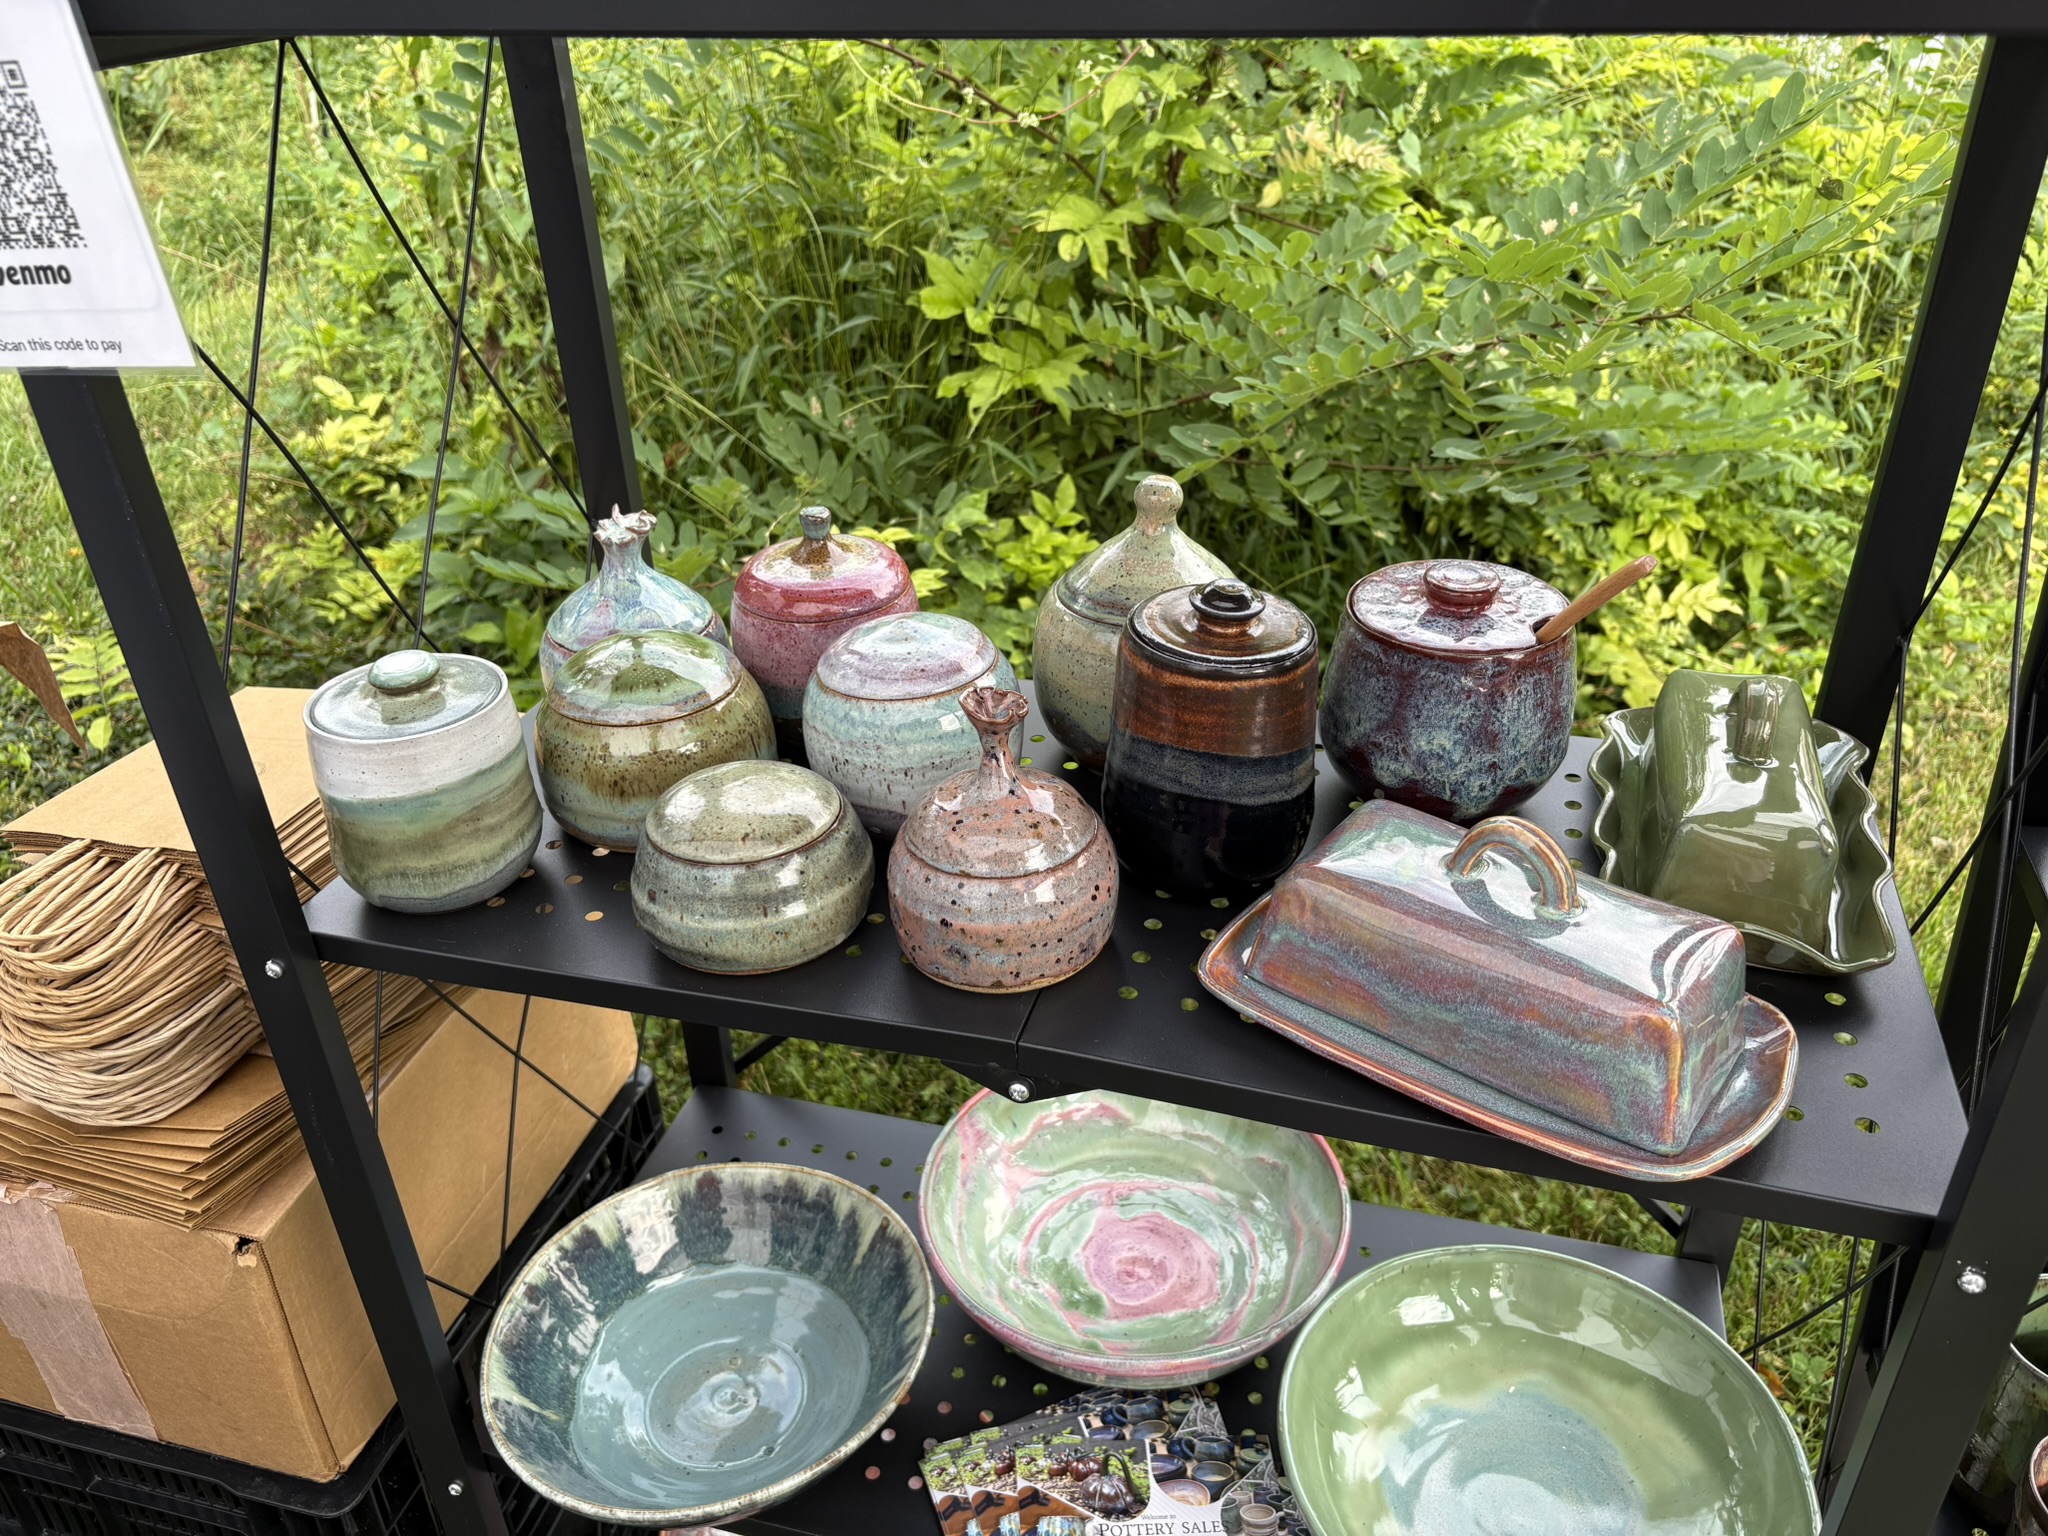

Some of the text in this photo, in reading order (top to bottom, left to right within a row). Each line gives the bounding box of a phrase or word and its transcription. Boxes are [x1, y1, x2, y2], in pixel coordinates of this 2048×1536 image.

[0, 337, 122, 353] Scan this code to pay
[1099, 1520, 1230, 1536] POTTERY SALES
